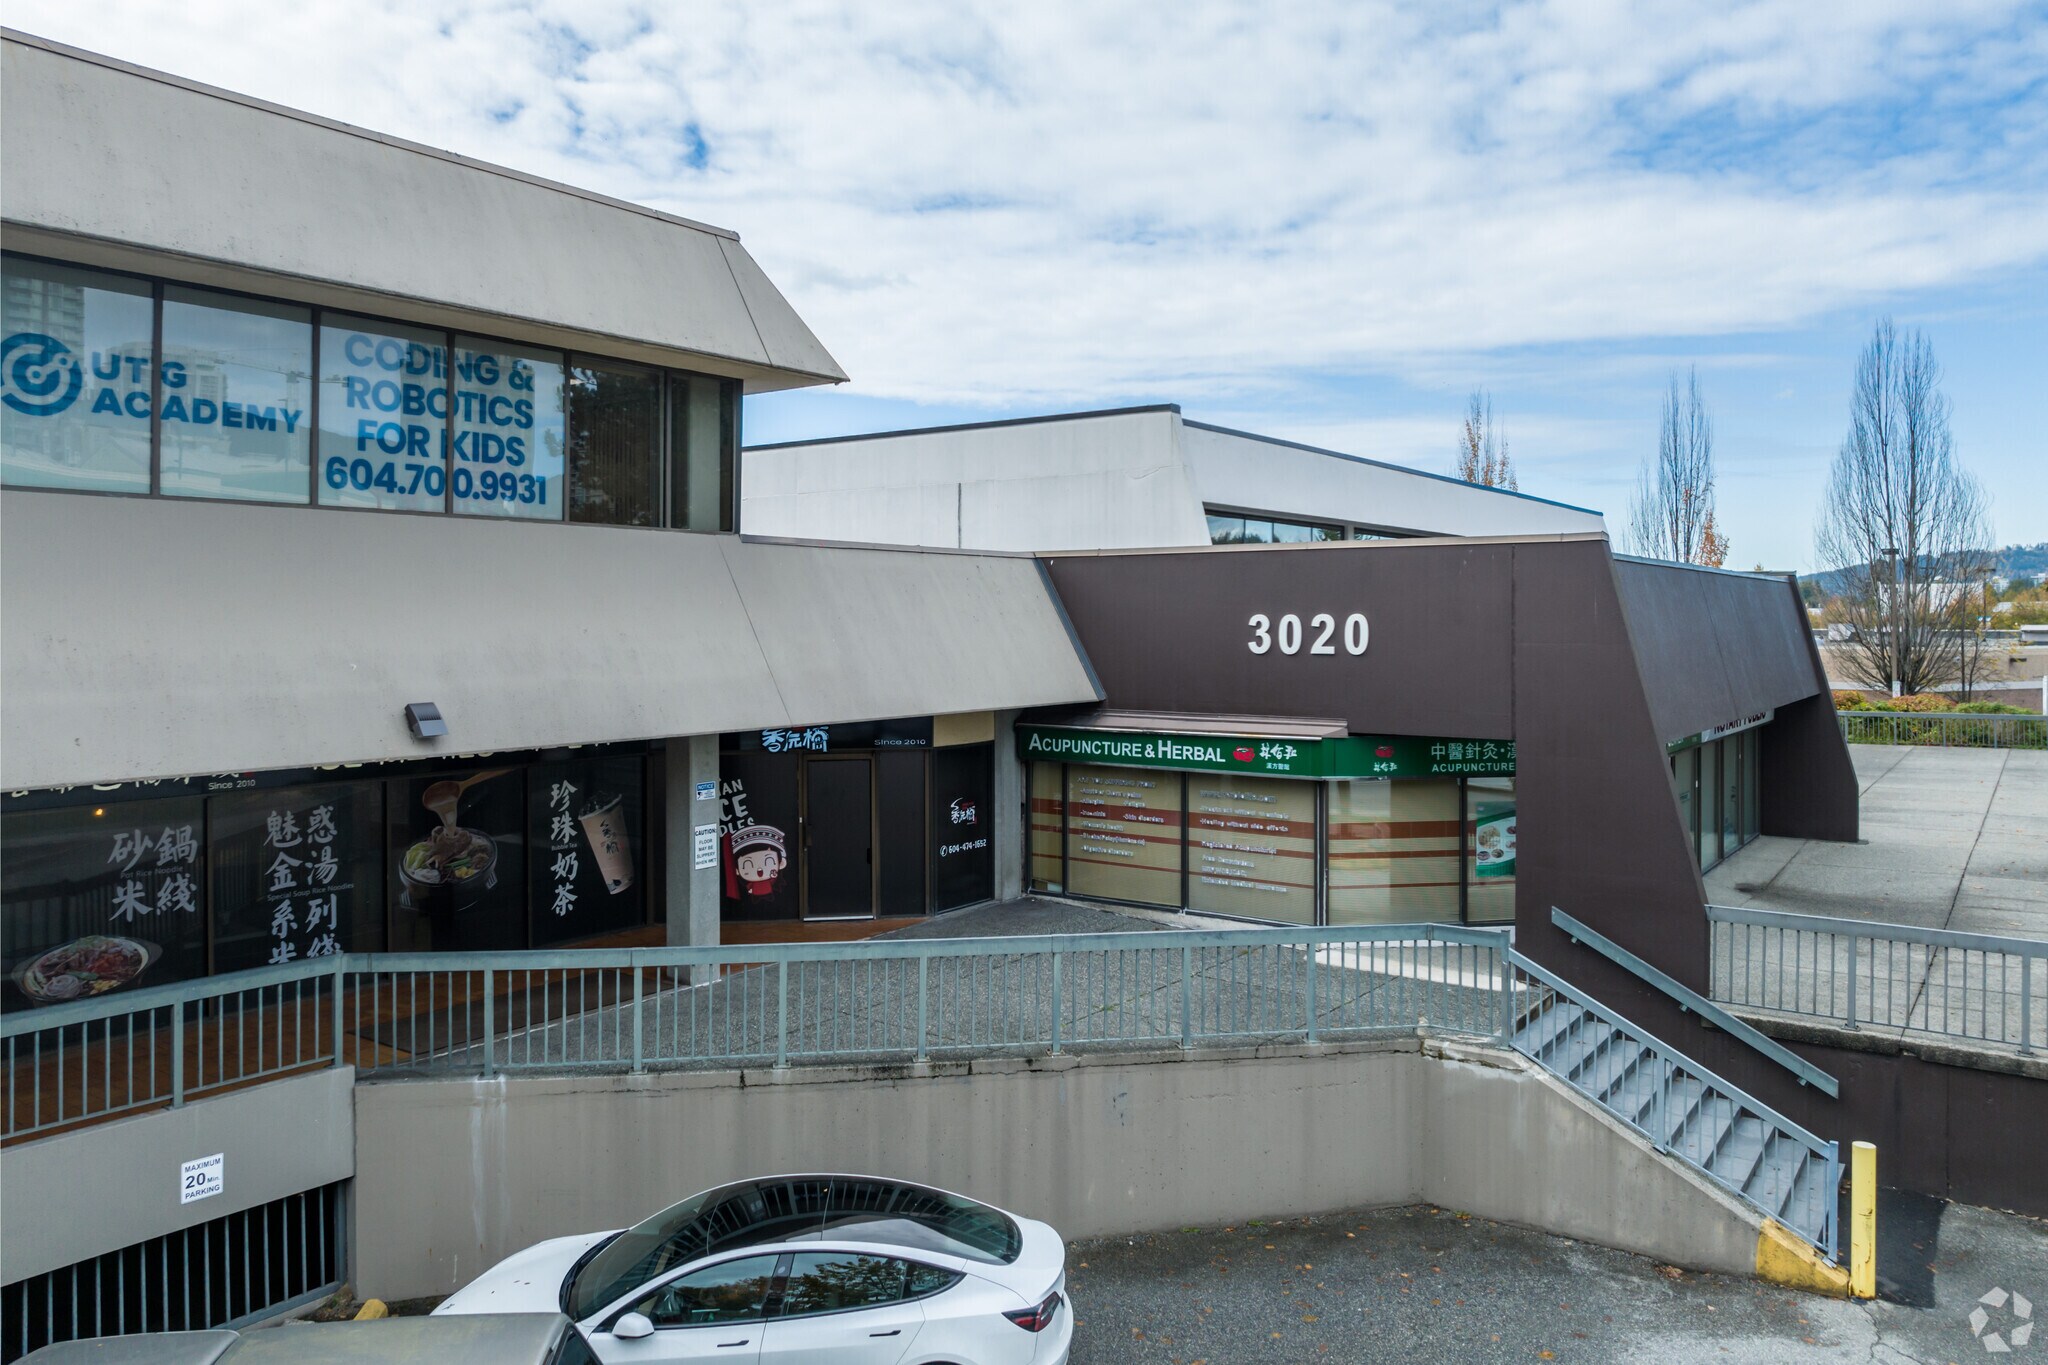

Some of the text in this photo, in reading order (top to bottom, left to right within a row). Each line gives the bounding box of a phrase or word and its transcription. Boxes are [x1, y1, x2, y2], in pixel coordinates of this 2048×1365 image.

[92, 351, 187, 388] UTG
[344, 334, 535, 393] CODING &
[92, 387, 303, 434] ACADEMY
[346, 375, 536, 430] ROBOTICS
[356, 418, 526, 467] FOR KIDS
[325, 456, 547, 506] 604.700.9931
[1247, 613, 1370, 656] 3020
[874, 738, 926, 746] Since 2010
[1028, 733, 1226, 762] ACUPUNCTURE & HERBAL
[208, 779, 256, 790] Since 2010
[1431, 762, 1516, 772] ACUPUNCTURE
[550, 780, 579, 916] 珍珠奶茶
[184, 1158, 221, 1173] MAXIMUM
[185, 1172, 206, 1189] 20
[185, 1184, 220, 1199] PARKING
